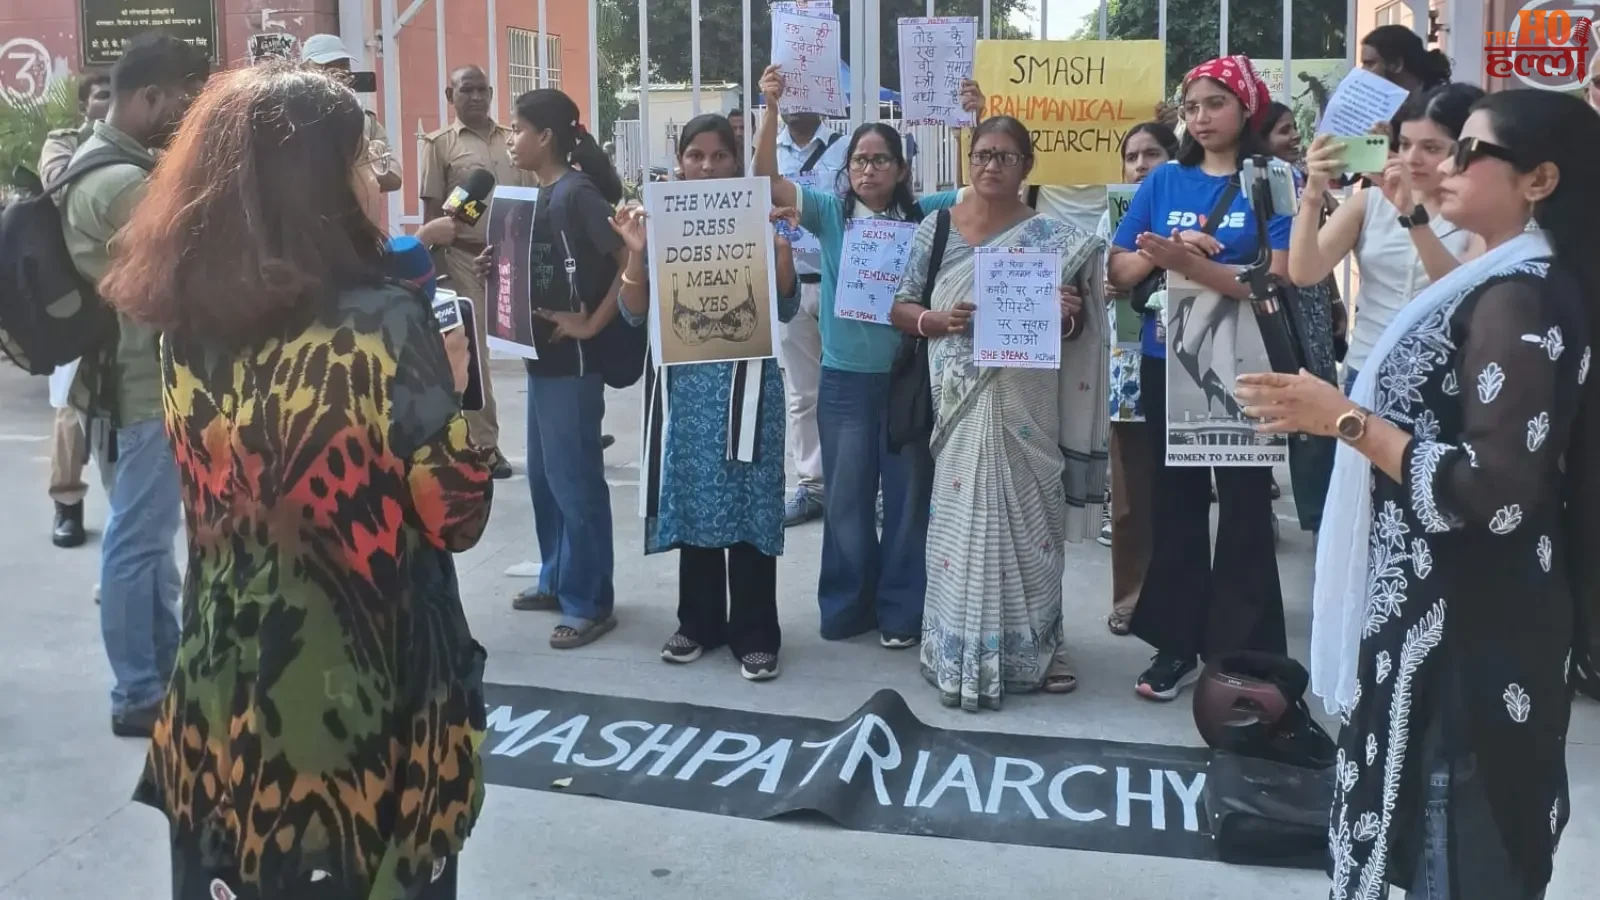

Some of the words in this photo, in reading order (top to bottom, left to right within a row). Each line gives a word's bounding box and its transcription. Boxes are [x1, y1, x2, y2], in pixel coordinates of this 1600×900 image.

[1010, 55, 1105, 85] SMASH
[981, 94, 1136, 122] RAHMANICAL
[1028, 129, 1127, 152] RIARCHY
[664, 193, 698, 212] THE
[703, 191, 742, 210] WAY
[746, 190, 752, 208] I
[682, 218, 736, 237] DRESS
[863, 230, 896, 241] SEXISM
[665, 245, 712, 263] DOES
[717, 242, 756, 261] NOT
[686, 268, 738, 287] MEAN
[858, 269, 900, 283] FEMINISM
[700, 296, 728, 312] YES
[980, 350, 998, 360] SHE
[1001, 350, 1029, 360] SPEAKS
[1168, 453, 1205, 461] WOMEN
[1208, 453, 1222, 461] TO
[1225, 453, 1254, 461] TAKE
[1257, 453, 1286, 462] OVER
[485, 704, 1206, 832] MASHPATRIARCHY
